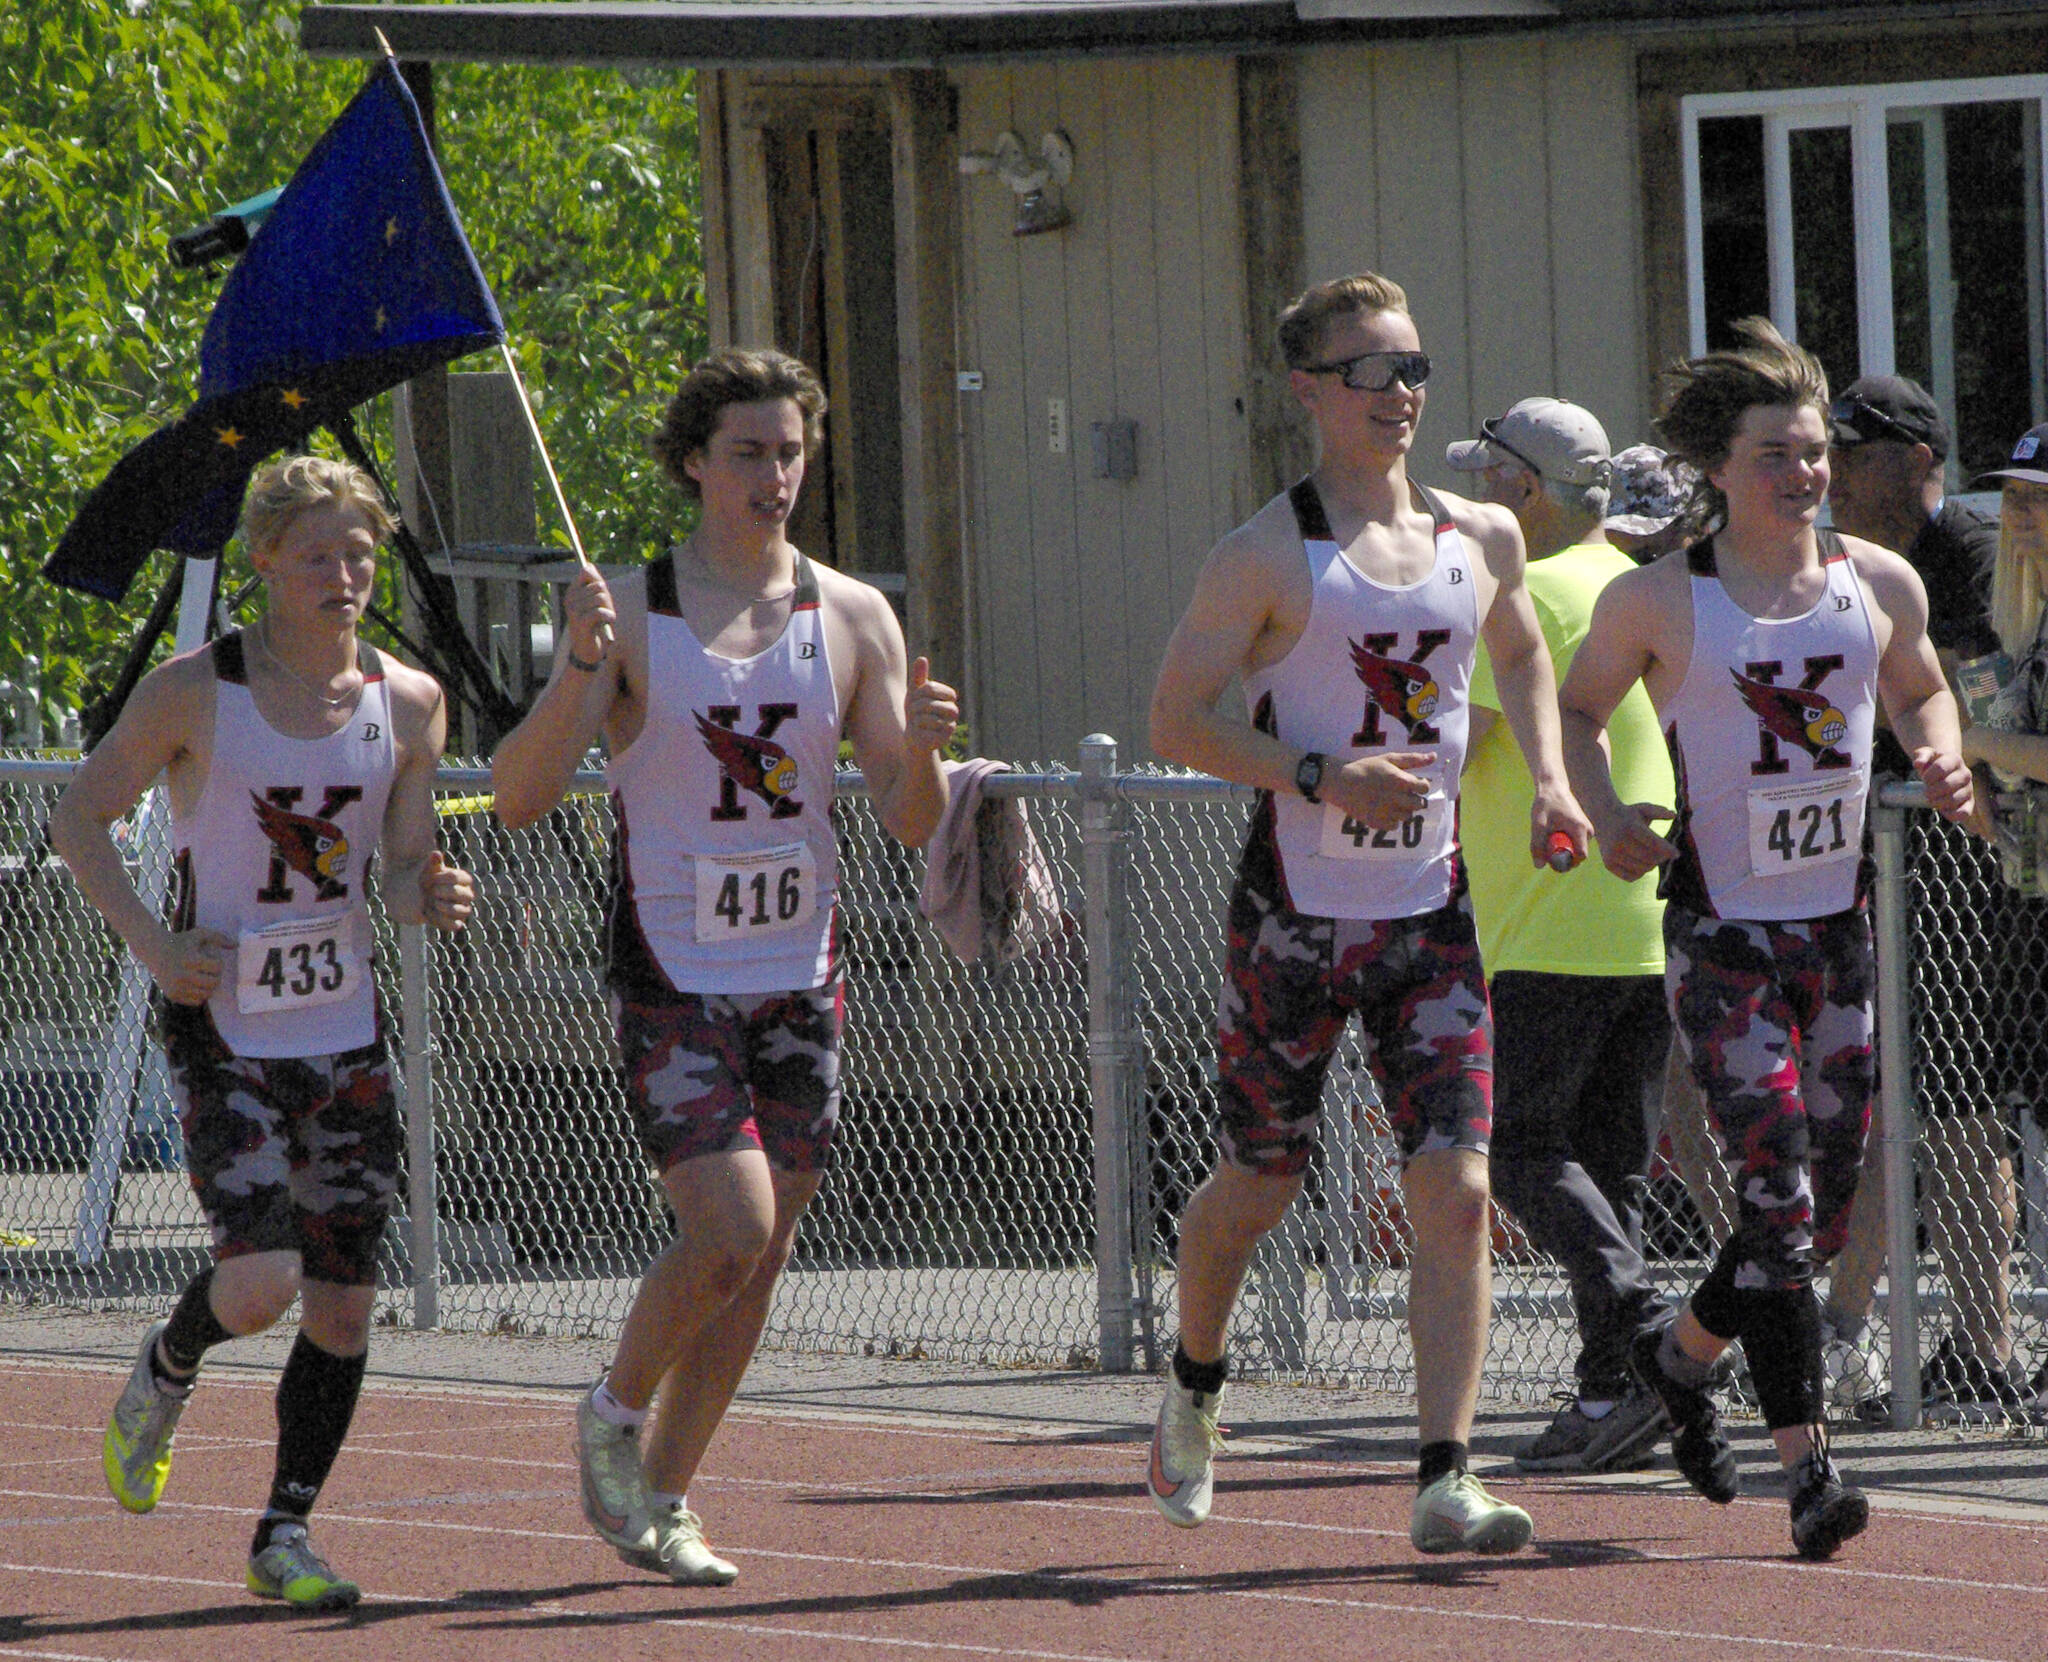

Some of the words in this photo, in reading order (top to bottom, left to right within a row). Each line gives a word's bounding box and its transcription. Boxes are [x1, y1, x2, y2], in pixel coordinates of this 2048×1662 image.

[1767, 798, 1847, 861] 421
[714, 866, 801, 928] 416
[256, 937, 344, 998] 433
